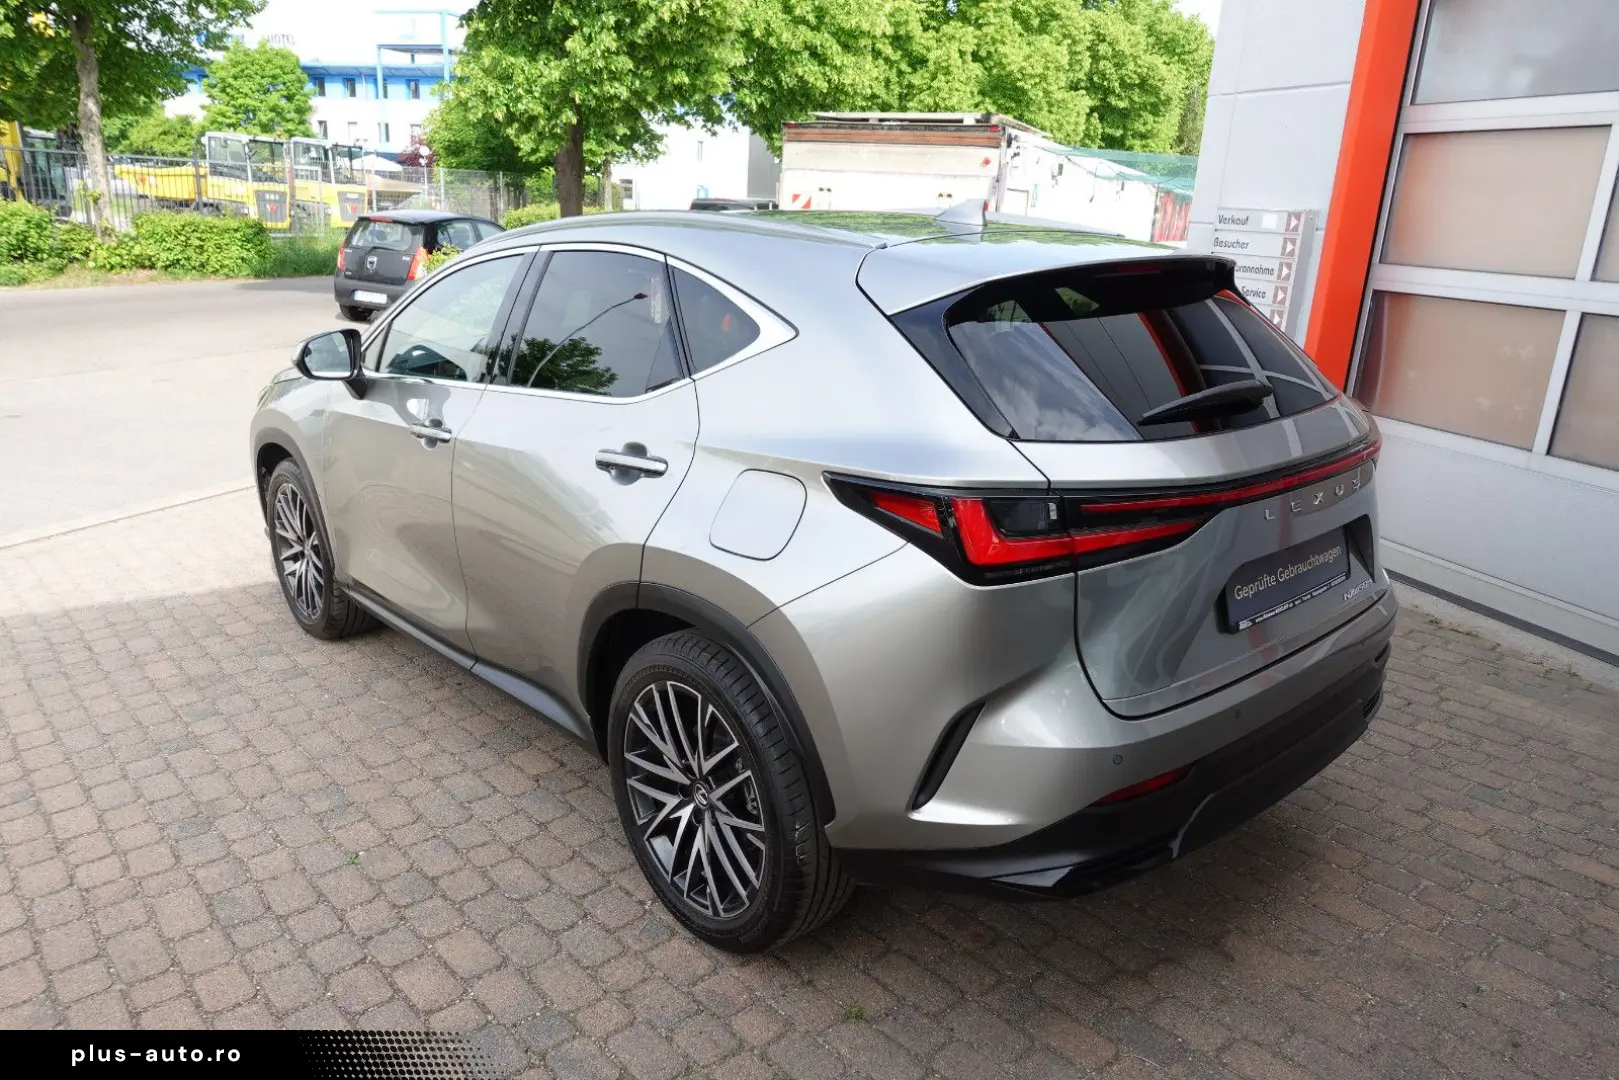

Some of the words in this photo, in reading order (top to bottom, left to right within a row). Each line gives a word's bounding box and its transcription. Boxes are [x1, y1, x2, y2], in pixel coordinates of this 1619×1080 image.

[1218, 214, 1249, 226] Verkauf
[1213, 237, 1250, 249] Besucher
[1241, 286, 1266, 298] Service
[1265, 477, 1361, 520] LEXUS
[1234, 574, 1276, 599] Geprüfte
[1277, 545, 1342, 582] Gebrauchtwagen
